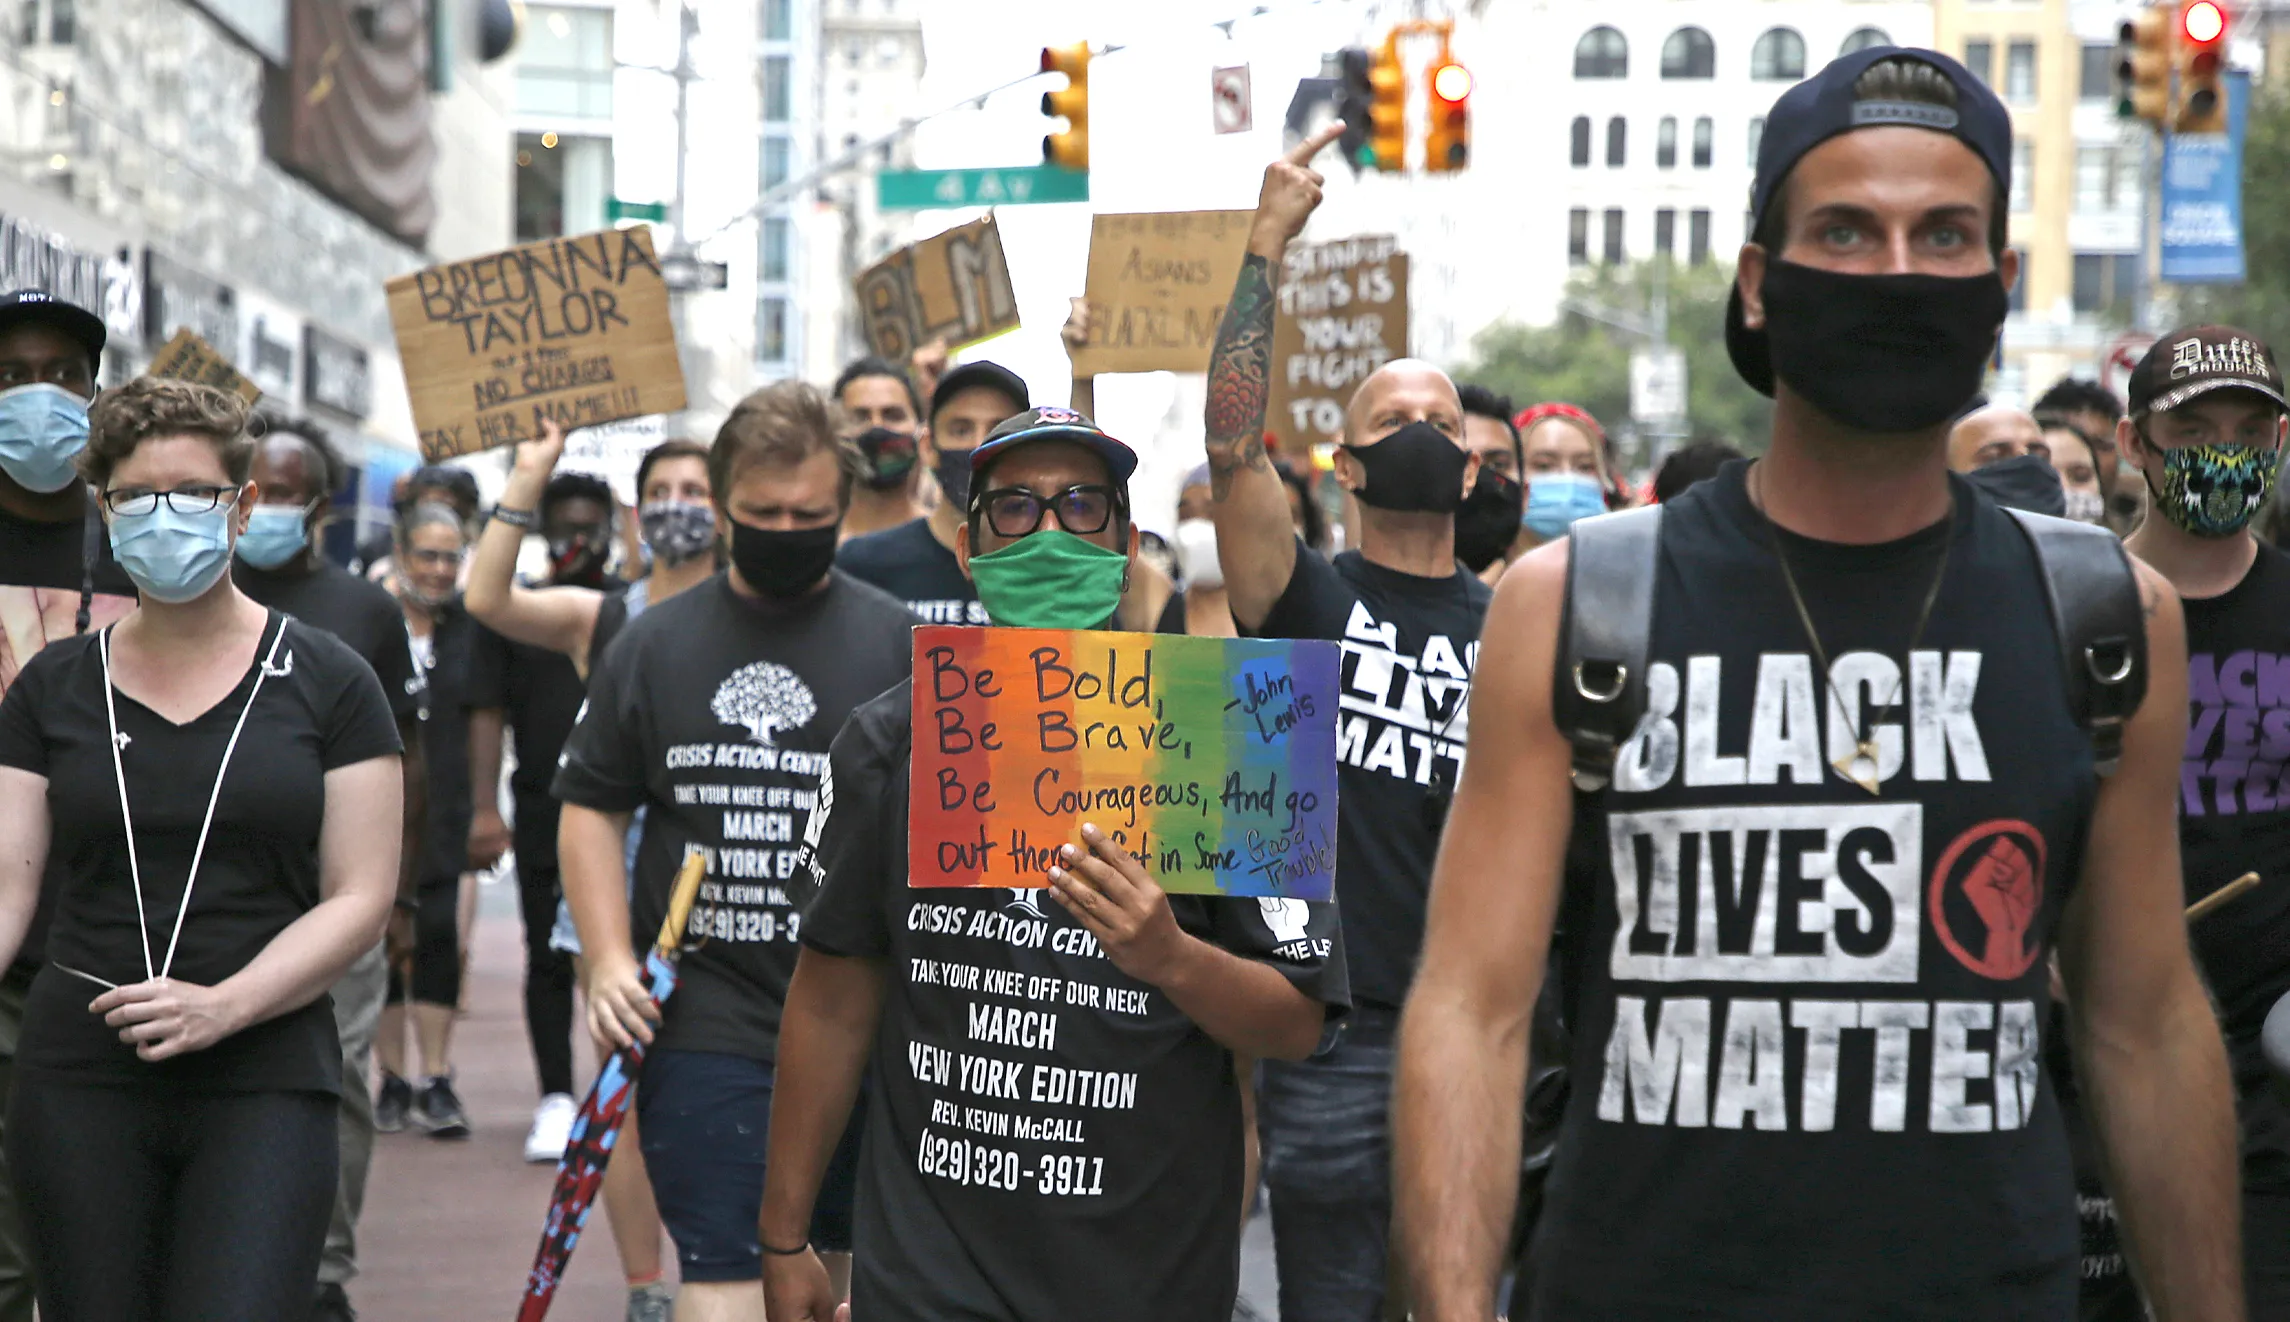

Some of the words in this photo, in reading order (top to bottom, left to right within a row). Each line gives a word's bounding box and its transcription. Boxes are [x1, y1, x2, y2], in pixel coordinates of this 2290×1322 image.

[934, 173, 966, 201] 4
[415, 230, 662, 321] BREONNA
[857, 227, 1015, 364] BLM
[1277, 272, 1352, 315] THIS
[1358, 267, 1395, 304] IS
[449, 289, 629, 355] TAYLOR
[1298, 313, 1385, 351] YOUR
[473, 376, 510, 411] NO
[1287, 348, 1390, 389] FIGHT
[420, 424, 464, 460] SAY
[476, 410, 529, 449] HER
[1290, 397, 1344, 434] TO
[926, 646, 1003, 702] Be
[1029, 645, 1164, 720] Bold,
[1340, 650, 1465, 723] LIV
[2187, 650, 2290, 707] ACK
[935, 707, 1003, 756] Be
[1038, 710, 1191, 758] Brave,
[1255, 694, 1315, 744] Lewis
[1613, 650, 1992, 792] BLACK
[2182, 707, 2290, 760] VES
[666, 743, 715, 769] CRISIS
[714, 743, 780, 770] ACTION
[1335, 712, 1467, 794] MATT
[674, 784, 697, 805] TAKE
[698, 784, 731, 805] YOUR
[732, 786, 767, 807] KNEE
[767, 787, 792, 808] OFF
[937, 767, 997, 812] Be
[1034, 767, 1208, 828] Courageous,
[1219, 771, 1277, 818] And
[1280, 791, 1318, 833] go
[723, 811, 793, 842] MARCH
[938, 824, 998, 874] out
[1159, 841, 1182, 874] in
[1246, 816, 1306, 862] Good
[719, 847, 774, 878] YORK
[727, 884, 766, 905] KEVIN
[1628, 826, 1898, 959] LIVES
[907, 902, 967, 935] CRISIS
[966, 909, 1048, 949] ACTION
[1273, 940, 1311, 962] THE
[941, 962, 980, 991] YOUR
[983, 968, 1025, 997] KNEE
[1027, 975, 1062, 1002] OFF
[1066, 980, 1100, 1009] OUR
[1104, 987, 1149, 1016] NECK
[967, 1001, 1057, 1051] MARCH
[908, 1041, 952, 1087] NEW
[959, 1053, 1024, 1100] YORK
[1030, 1065, 1138, 1109] EDITION
[1597, 995, 2040, 1134] MATTER
[931, 1099, 961, 1127] REV.
[965, 1107, 1009, 1137] KEVIN
[1013, 1115, 1085, 1143] McCALL
